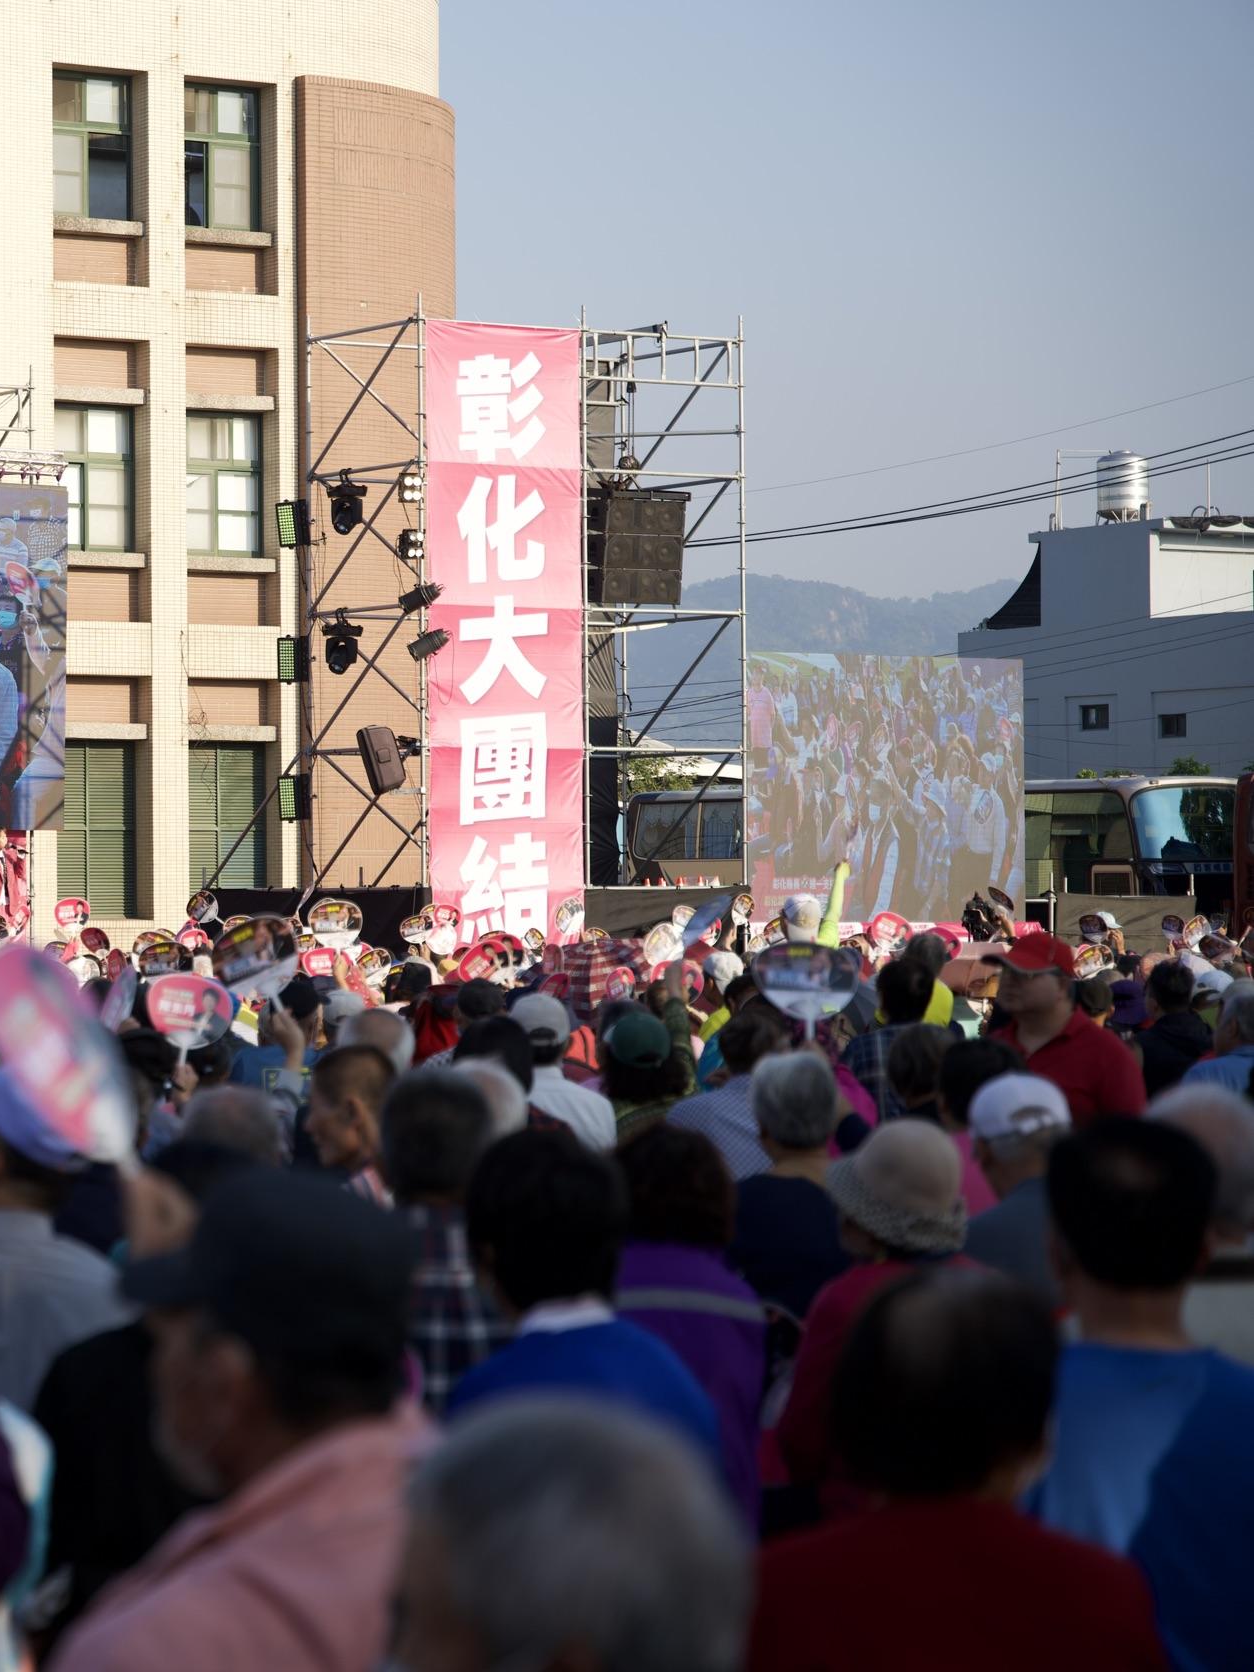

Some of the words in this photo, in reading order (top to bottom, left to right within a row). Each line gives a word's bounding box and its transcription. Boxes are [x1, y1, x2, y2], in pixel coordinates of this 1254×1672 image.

[456, 351, 548, 943] 彰化大團結
